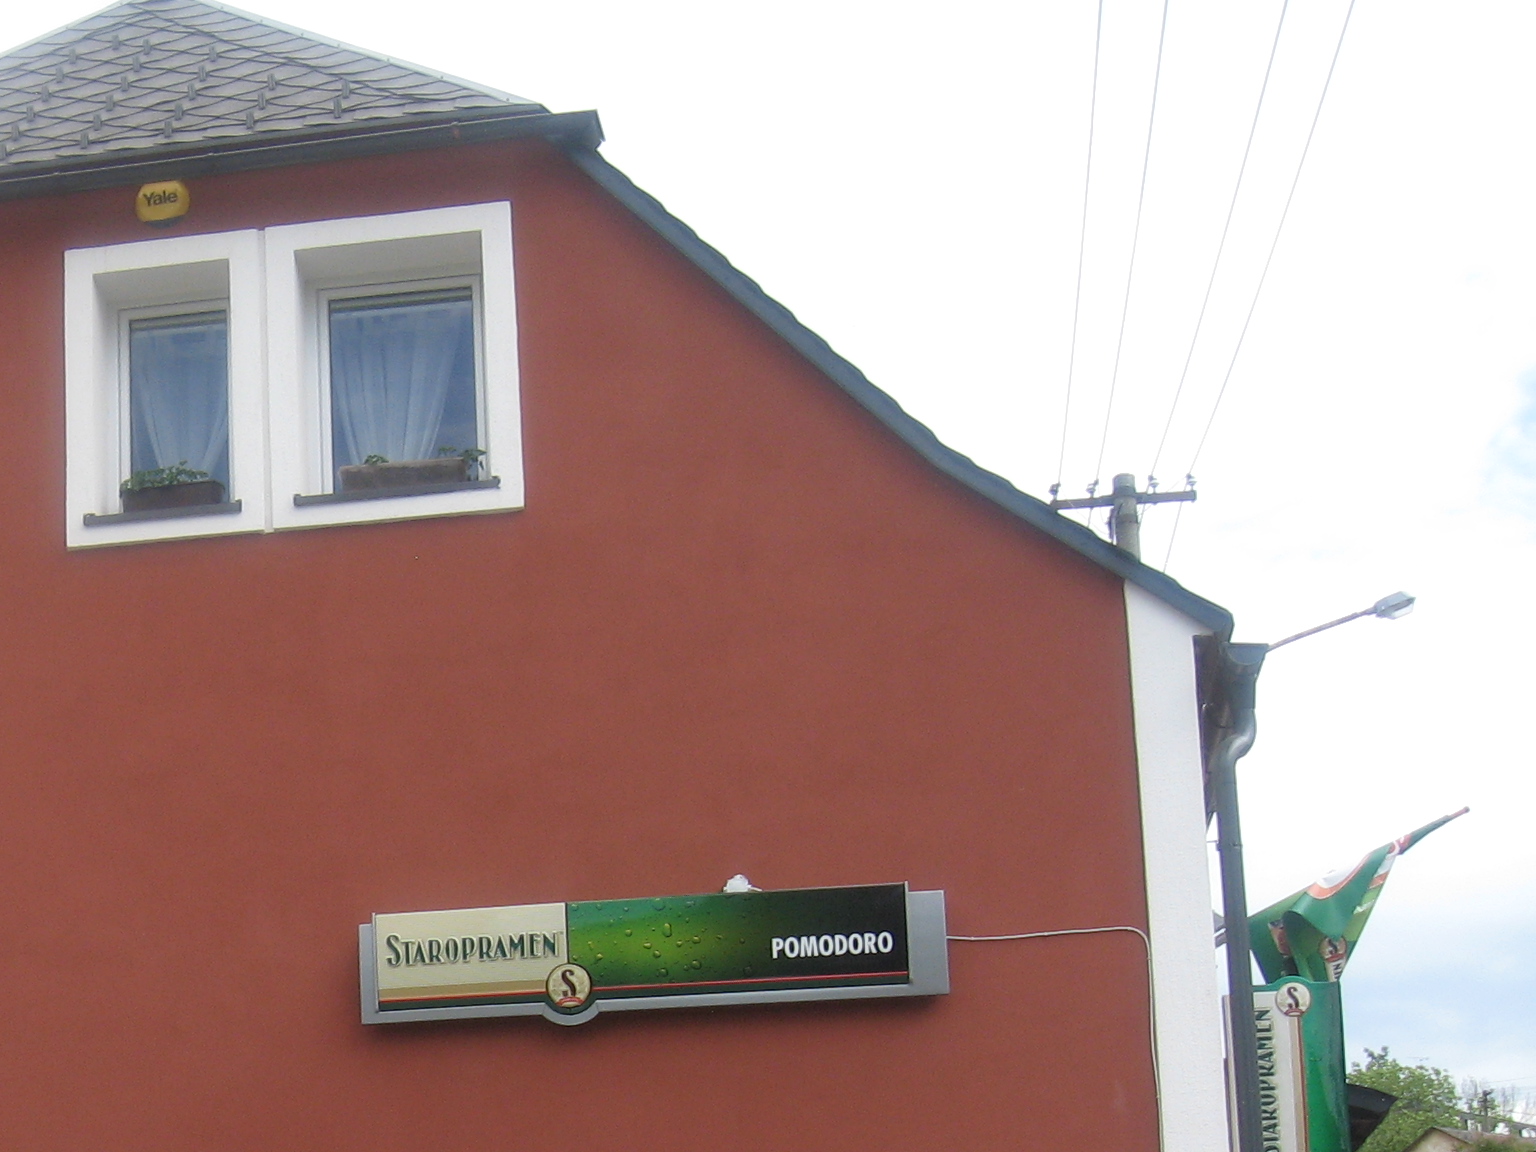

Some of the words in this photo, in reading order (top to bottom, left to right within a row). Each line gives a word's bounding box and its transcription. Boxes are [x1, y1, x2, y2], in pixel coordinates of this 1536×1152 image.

[143, 190, 179, 207] Yale
[386, 933, 560, 967] STAROPRAMEN
[771, 931, 894, 959] POMODORO
